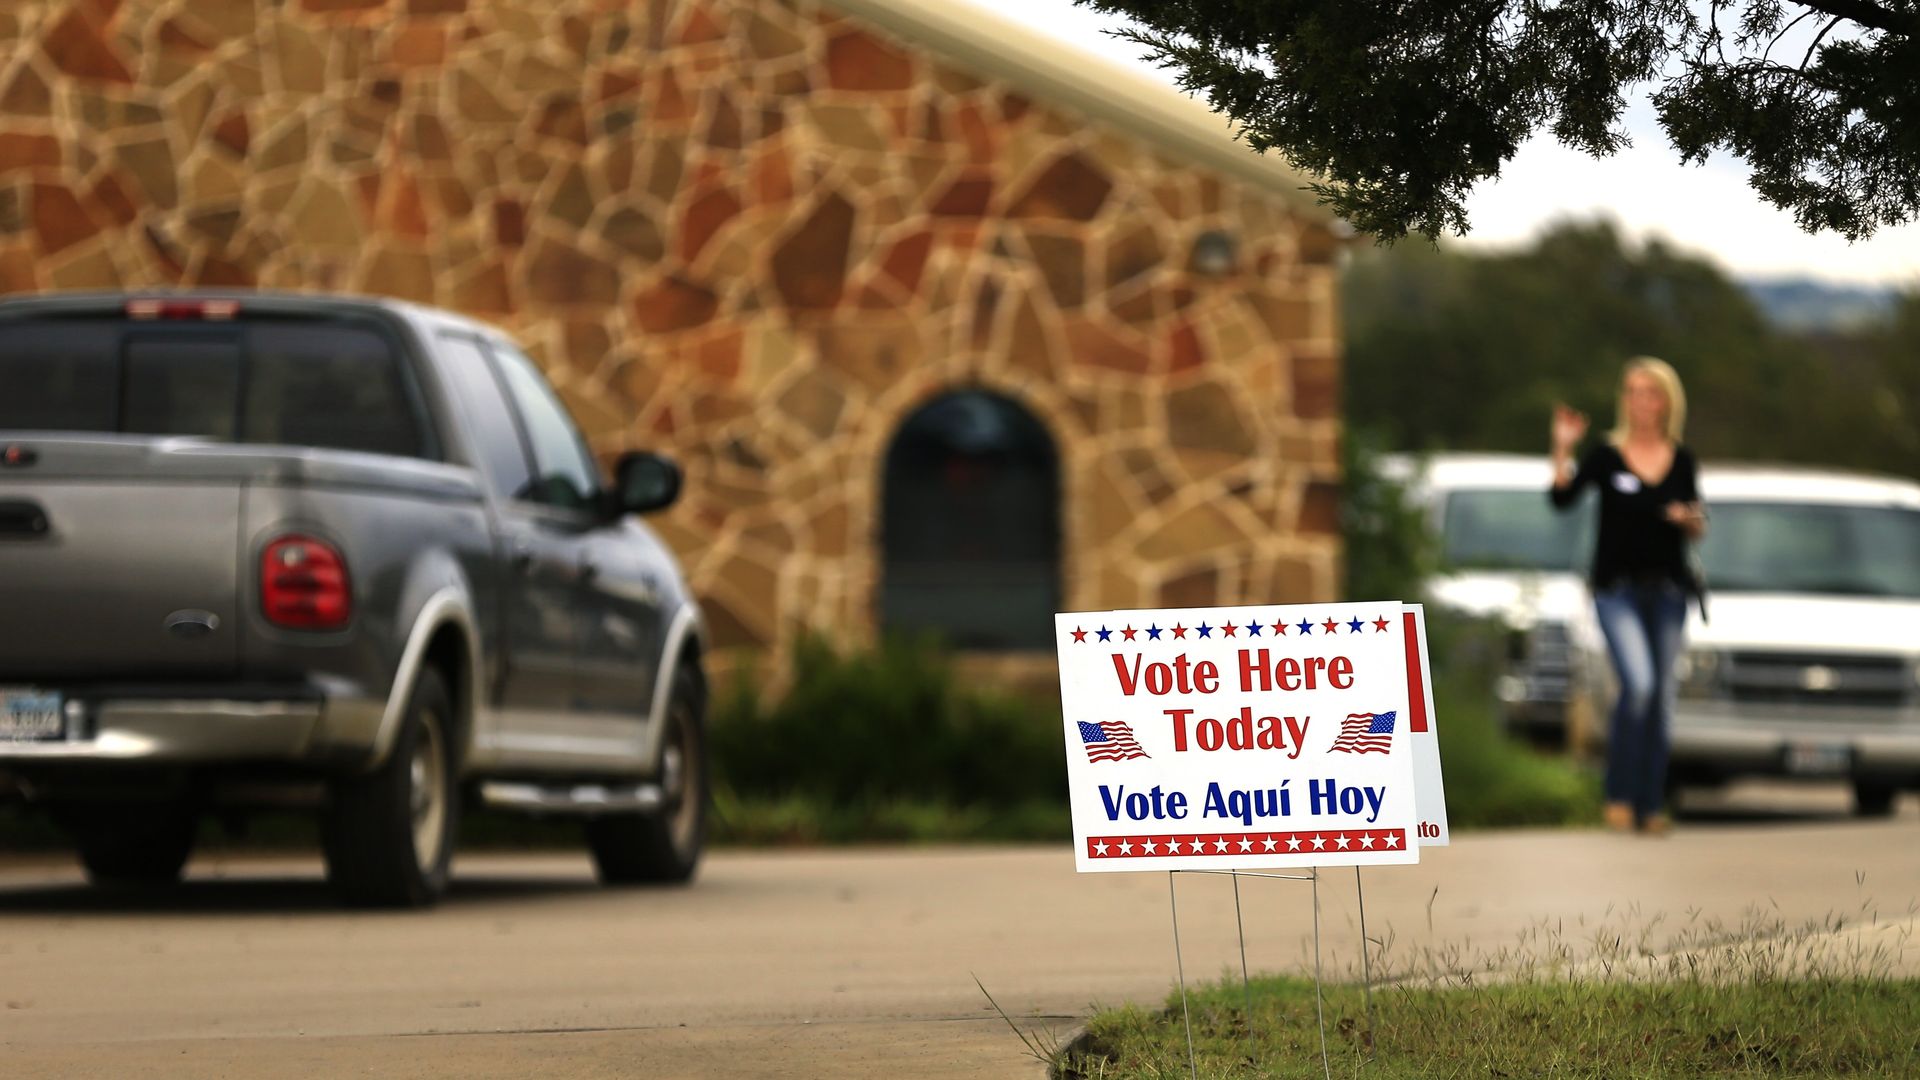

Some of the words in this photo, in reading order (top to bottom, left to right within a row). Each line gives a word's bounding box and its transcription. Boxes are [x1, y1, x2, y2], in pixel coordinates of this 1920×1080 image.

[1112, 653, 1219, 696] Vote
[1238, 649, 1354, 692] Here
[1163, 707, 1310, 759] Today
[1098, 785, 1188, 820] Vote
[1203, 779, 1290, 826] Aquí
[1309, 779, 1386, 823] Hoy
